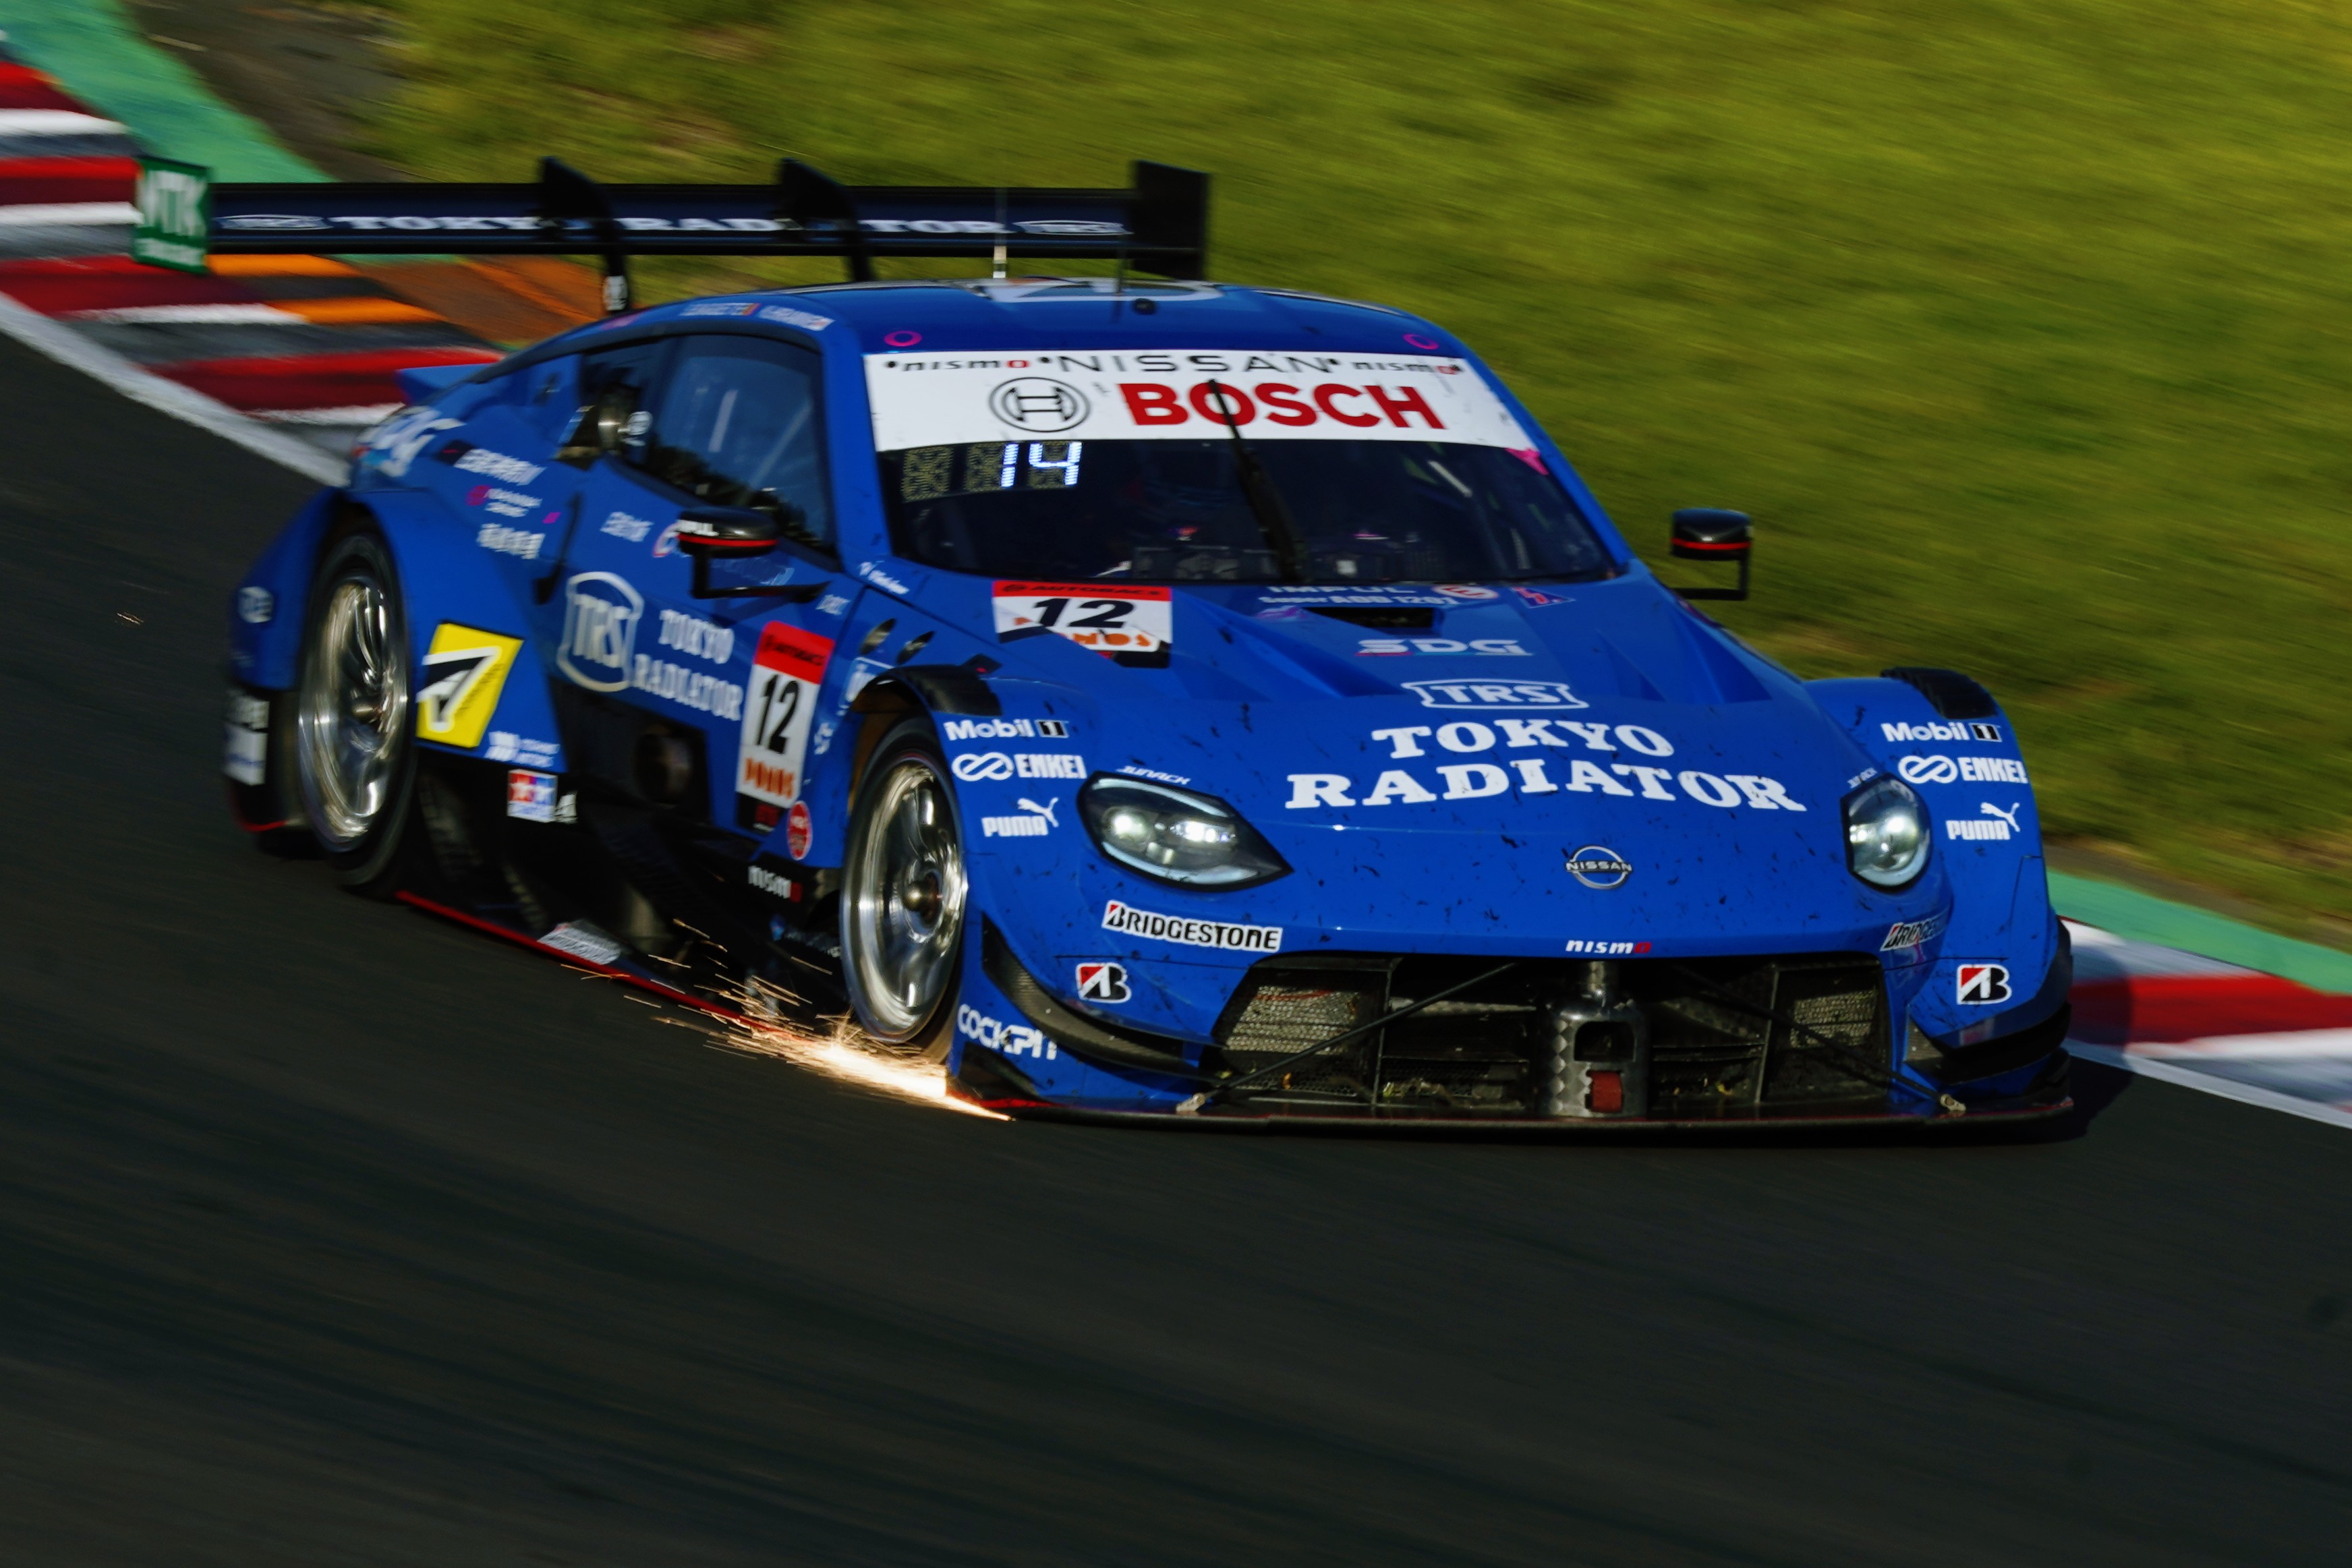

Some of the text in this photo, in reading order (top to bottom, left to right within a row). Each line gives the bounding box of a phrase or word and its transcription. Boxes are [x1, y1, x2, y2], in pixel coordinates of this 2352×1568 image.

[902, 359, 1030, 372] nismo
[1058, 355, 1333, 372] NISSAN
[1352, 361, 1458, 375] nismo
[1116, 382, 1448, 430] BOSCH
[1000, 442, 1082, 488] 14
[1033, 598, 1136, 629] 12
[658, 609, 735, 664] TOKYO
[1356, 638, 1532, 656] SDG
[632, 654, 743, 721] RADIATOR
[1430, 685, 1561, 703] TRS
[756, 674, 800, 756] 12
[944, 719, 1035, 741] Mobil
[1372, 719, 1674, 759] TOKYO
[1881, 722, 1970, 742] Mobil
[1014, 754, 1087, 779] ENKEI
[1285, 759, 1807, 811] RADIATOR
[982, 815, 1048, 837] PUMA
[1945, 820, 2011, 840] PUMA
[1566, 860, 1633, 872] NISSAN
[1107, 903, 1279, 950] BRIDGESTONE
[1565, 940, 1652, 955] nismo
